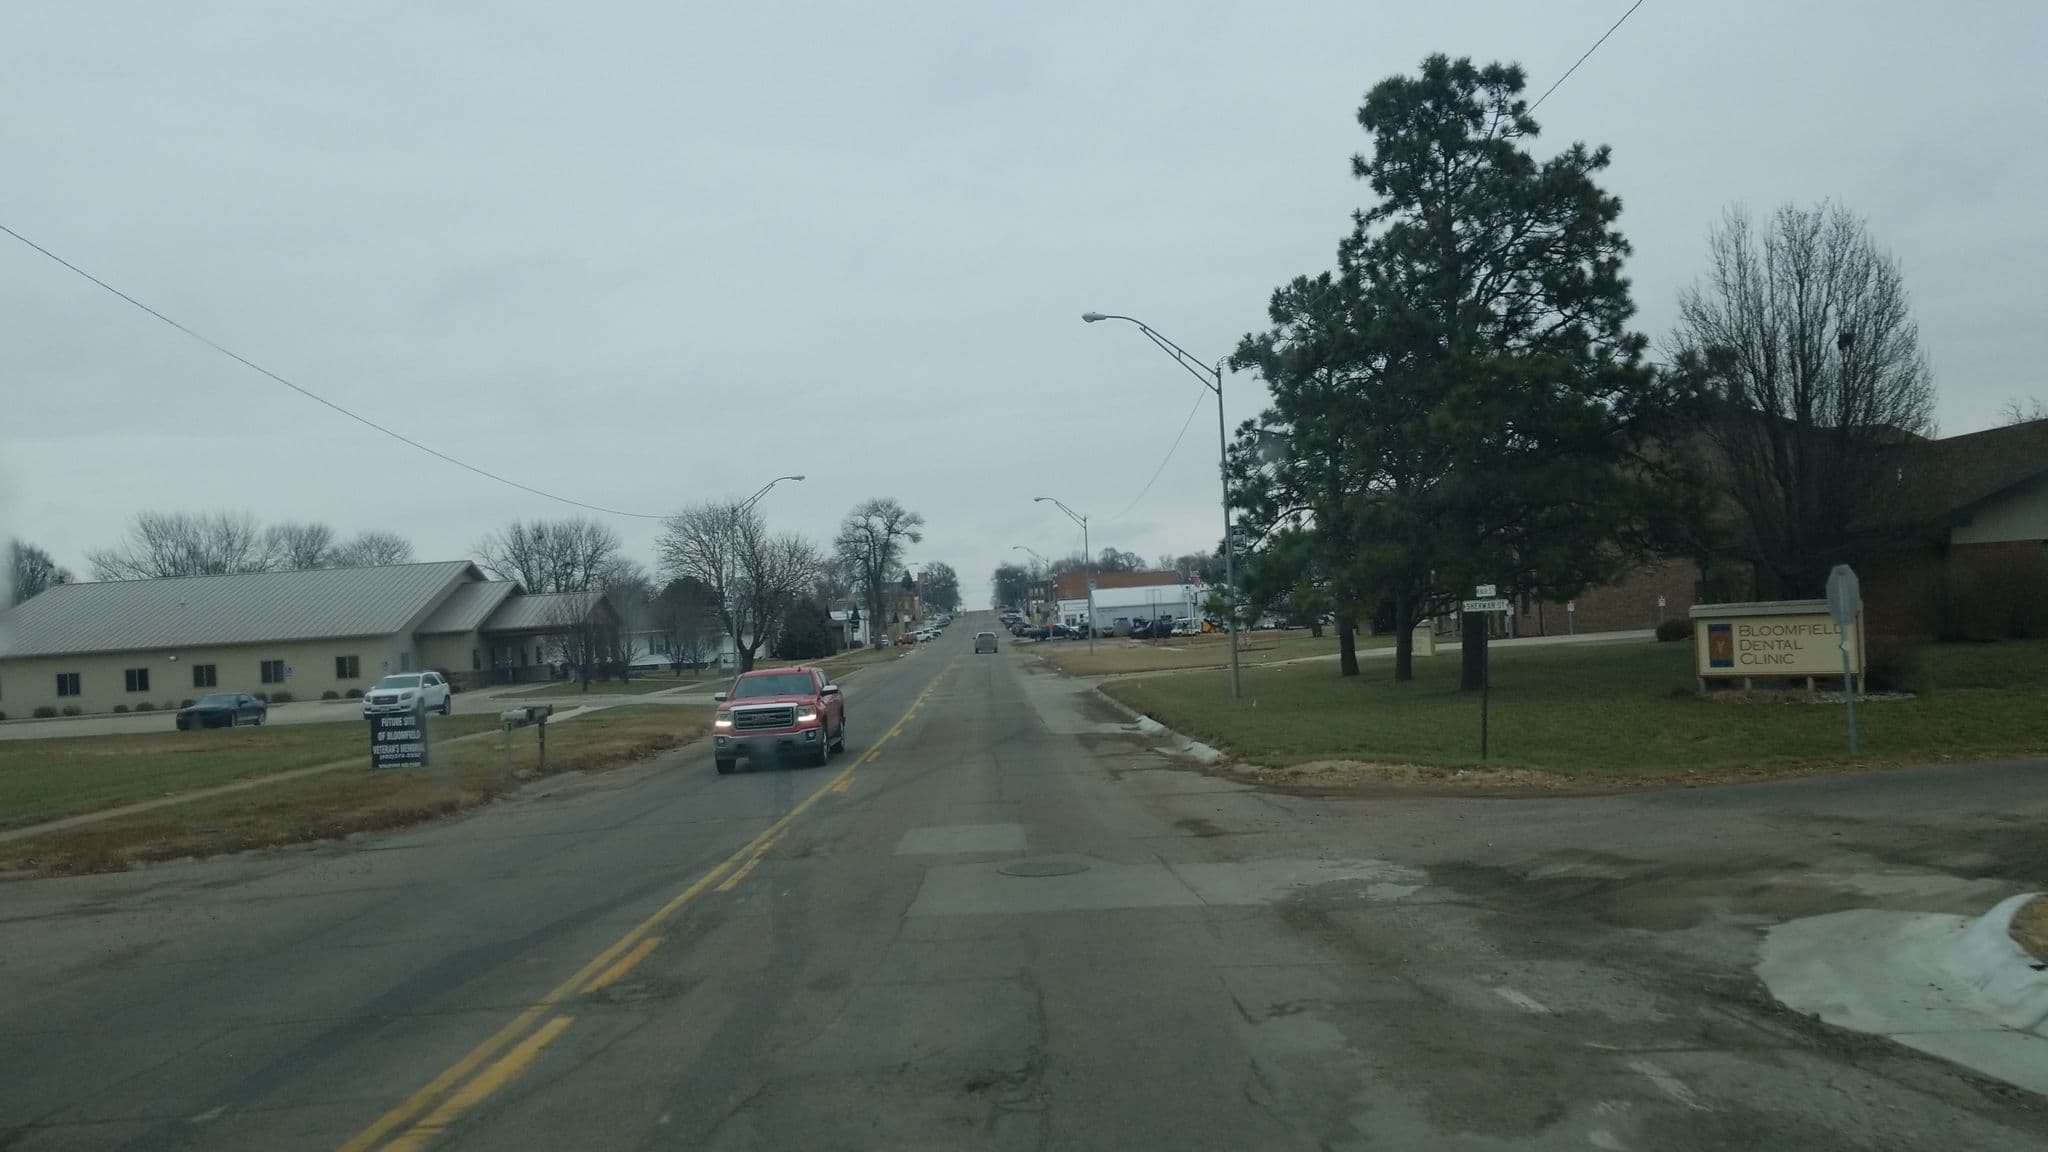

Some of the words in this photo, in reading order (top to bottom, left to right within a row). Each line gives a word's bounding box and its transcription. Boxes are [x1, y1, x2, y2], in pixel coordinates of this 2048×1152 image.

[1739, 624, 1843, 637] BLOOMFIELD
[1740, 639, 1804, 651] DENTAL
[1740, 653, 1795, 665] CLINIC
[381, 717, 402, 727] FUTURE
[403, 716, 416, 726] SITE
[377, 731, 386, 741] OF
[386, 729, 421, 740] BLOOMFIELD
[400, 743, 425, 753] MEMO
